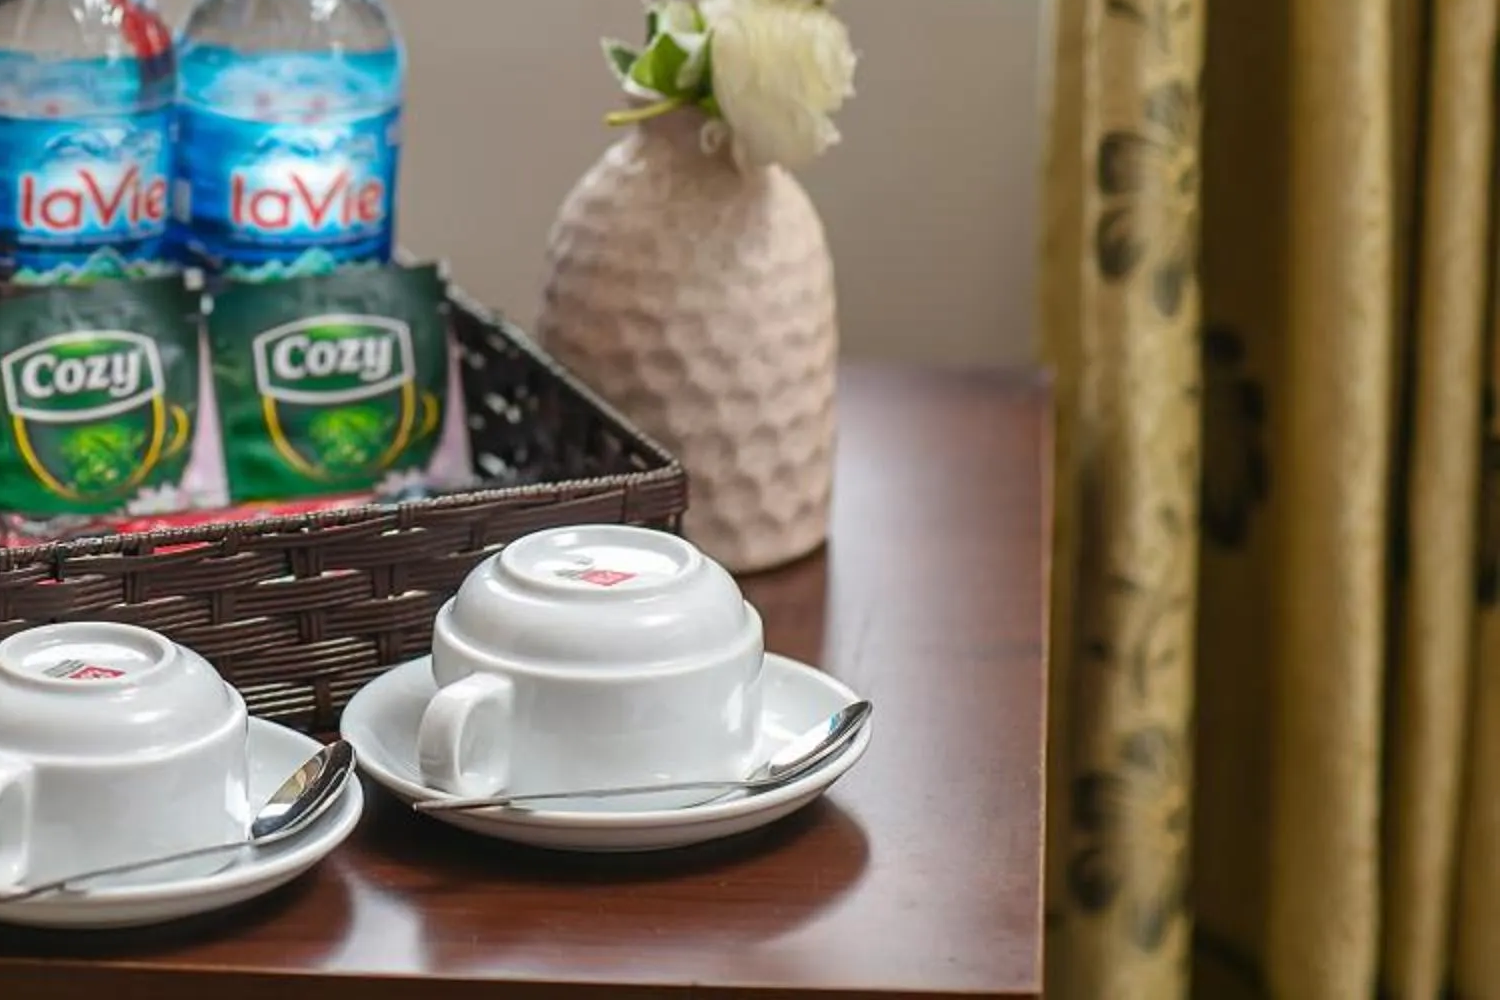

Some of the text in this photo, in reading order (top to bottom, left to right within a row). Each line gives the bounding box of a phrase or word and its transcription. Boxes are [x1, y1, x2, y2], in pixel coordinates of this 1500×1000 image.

[231, 168, 385, 230] laVie
[20, 352, 141, 399] Cozy
[272, 333, 394, 381] Cozy
